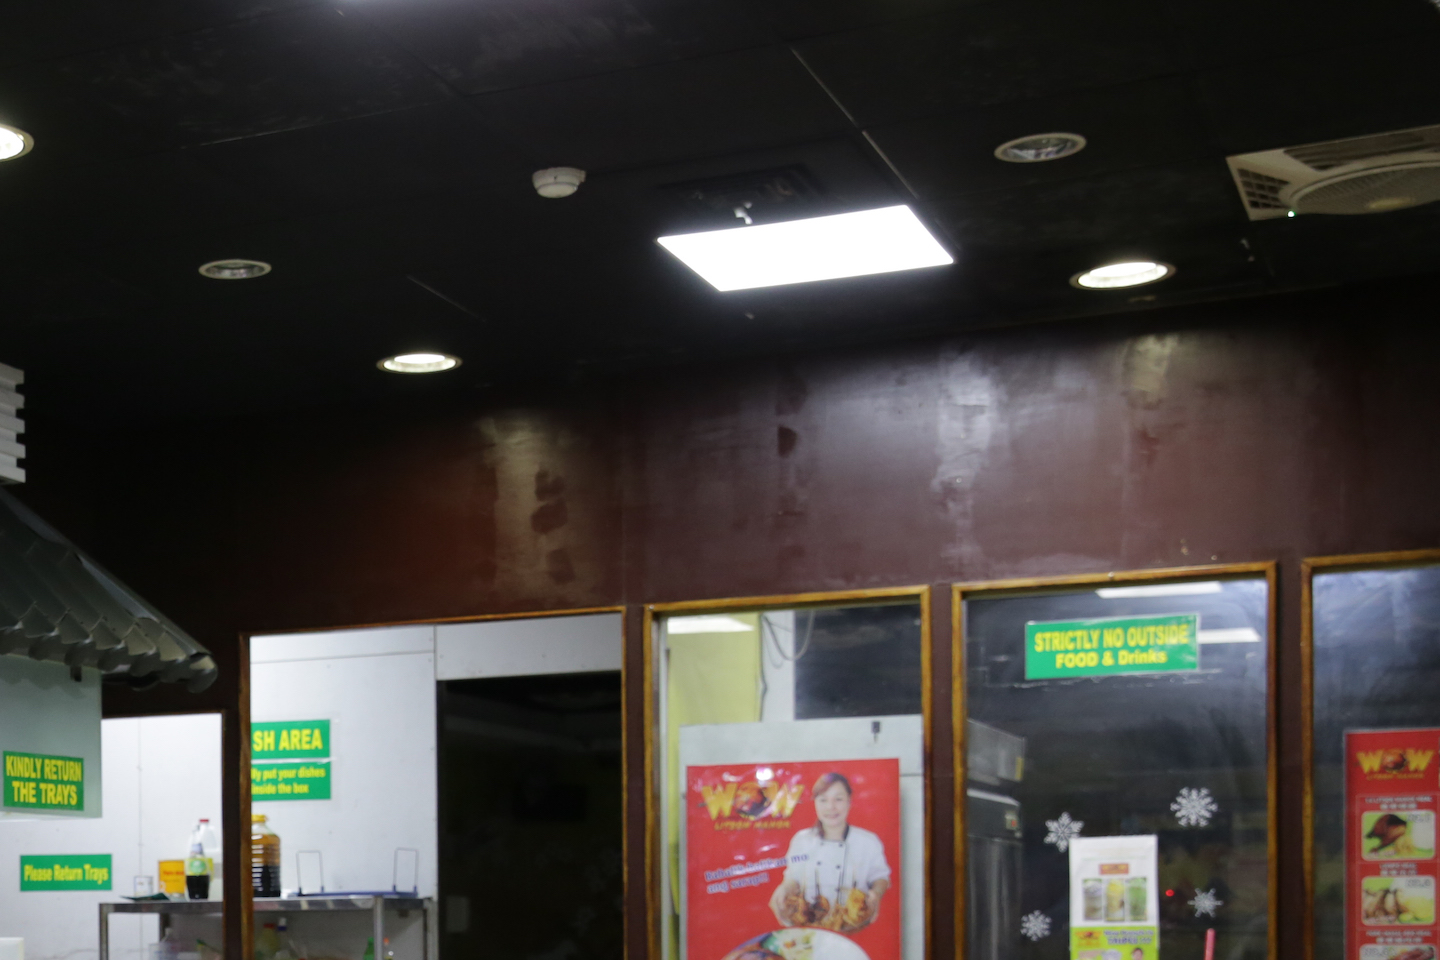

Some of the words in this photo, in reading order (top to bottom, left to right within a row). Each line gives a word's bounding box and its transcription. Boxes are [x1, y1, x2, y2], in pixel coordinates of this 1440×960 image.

[1034, 629, 1101, 652] STRICTLY
[1103, 627, 1125, 648] NO
[1127, 624, 1190, 647] OUTSIDE
[1055, 651, 1099, 669] FOOD
[1101, 650, 1115, 667] &
[1118, 648, 1168, 665] Drinks
[278, 728, 323, 751] AREA
[6, 756, 43, 779] KINDLY
[44, 759, 83, 783] RETURN
[278, 769, 297, 782] your
[297, 766, 326, 779] dishes
[12, 781, 37, 804] THE
[39, 783, 78, 806] TRAYS
[278, 782, 292, 794] the
[293, 782, 309, 794] box
[23, 864, 53, 881] Please
[54, 864, 83, 881] Return
[83, 864, 109, 885] Trays
